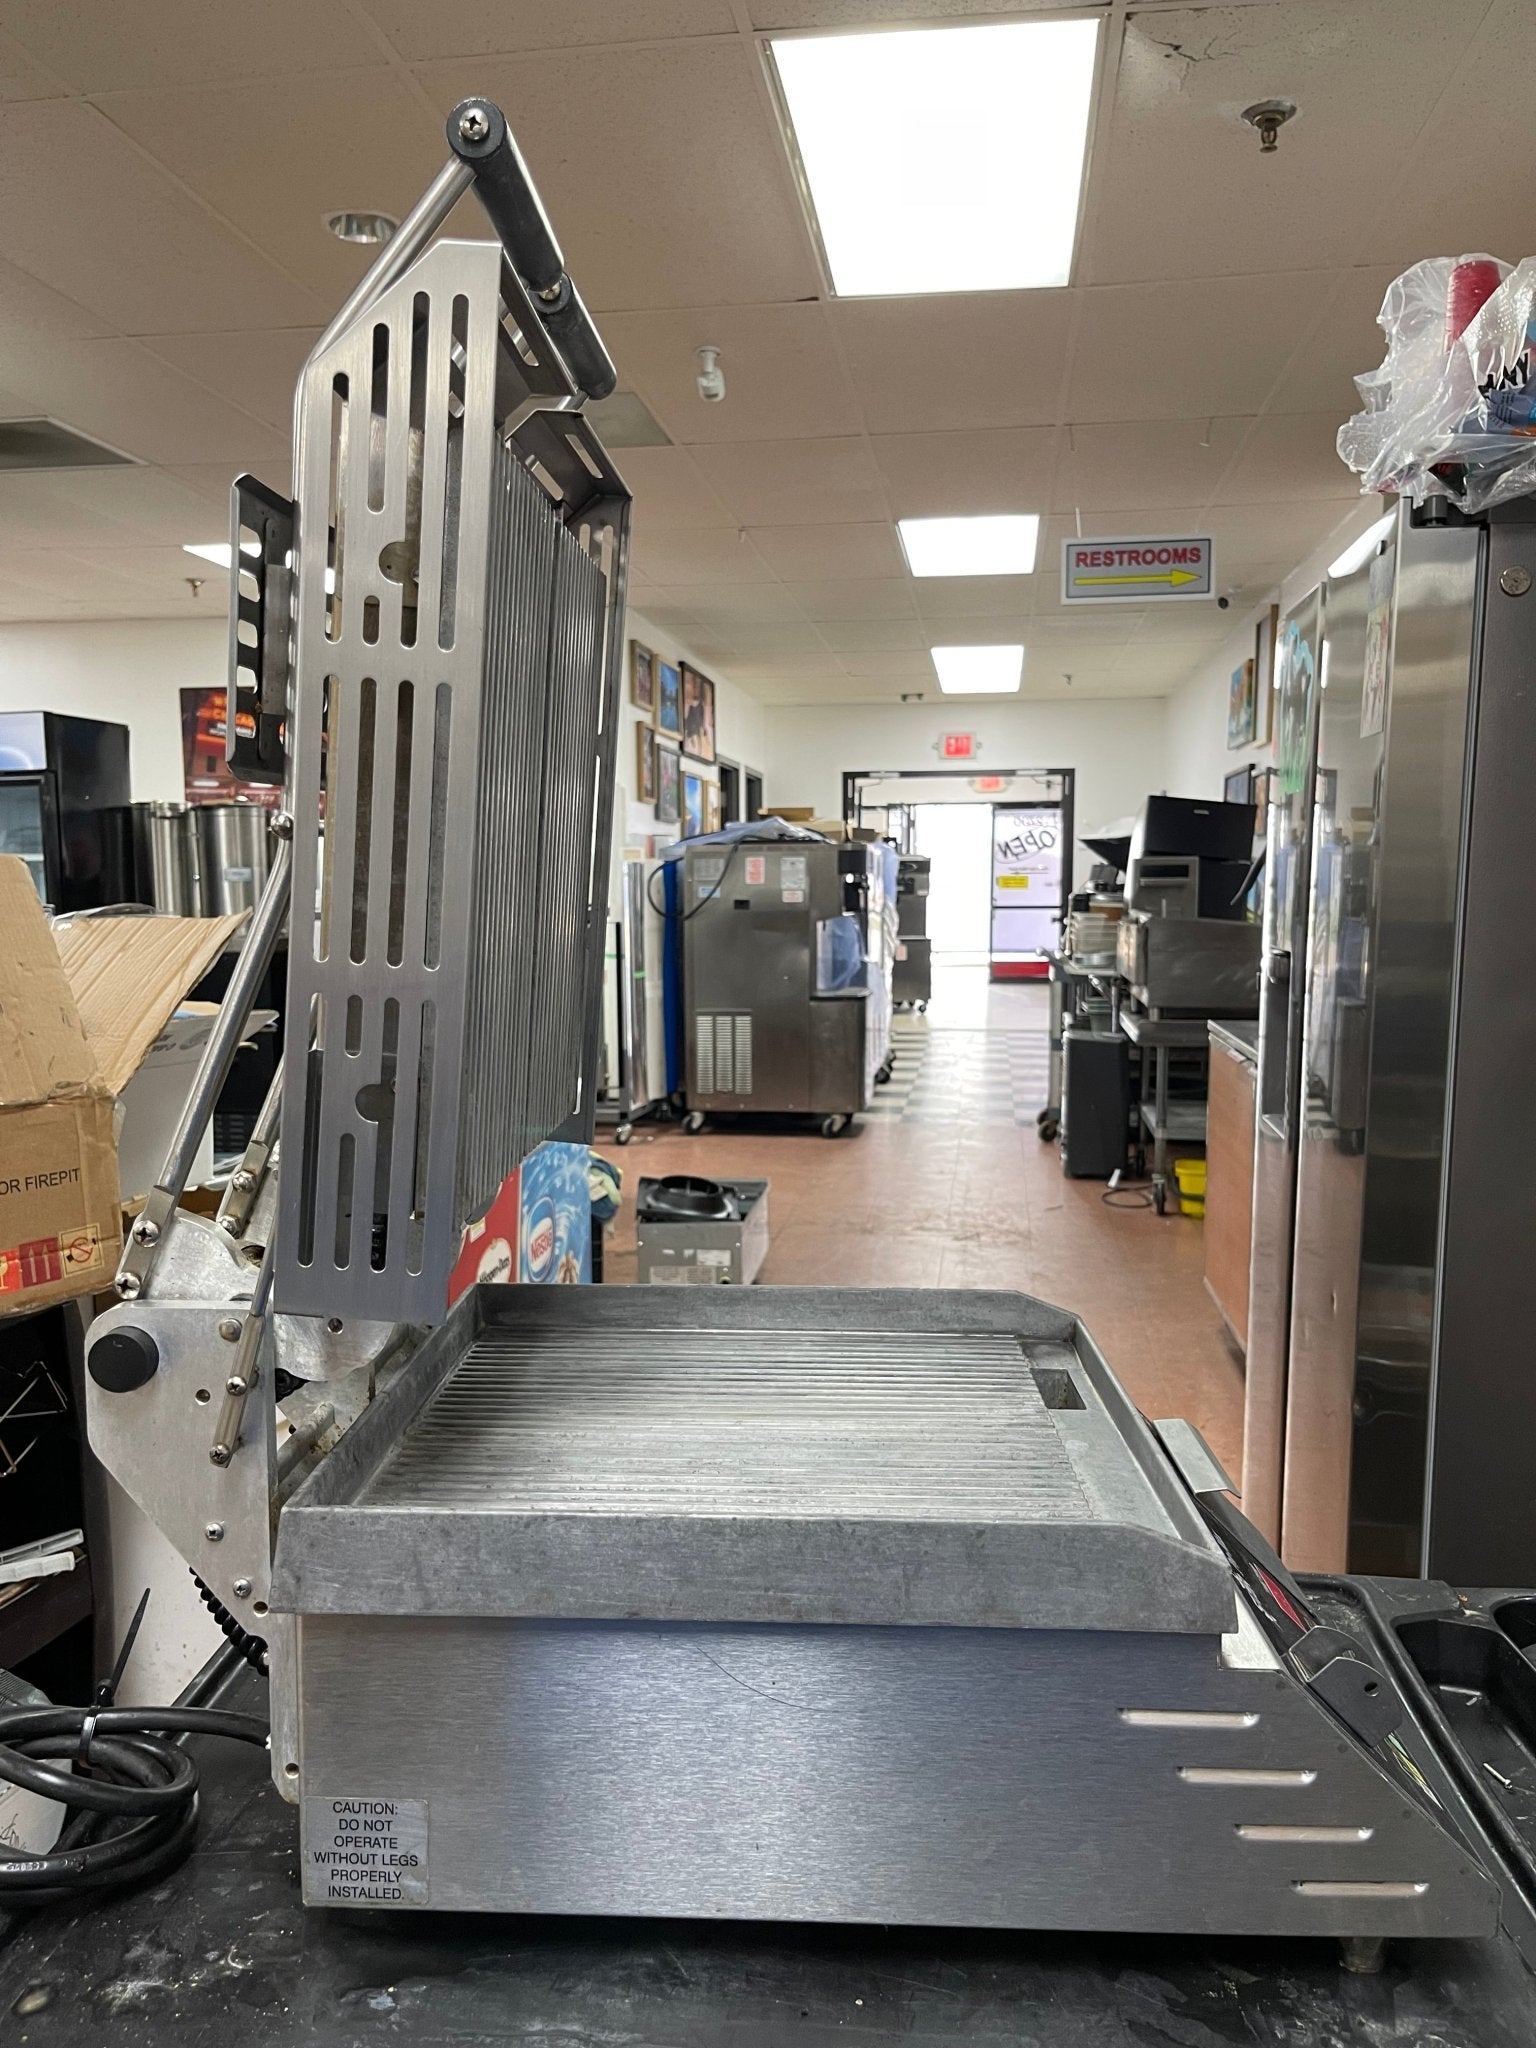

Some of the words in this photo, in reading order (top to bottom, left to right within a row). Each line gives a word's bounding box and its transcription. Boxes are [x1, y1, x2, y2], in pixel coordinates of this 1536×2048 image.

[1075, 547, 1202, 568] RESTROOMS
[25, 1167, 80, 1191] FIREPIT
[332, 1801, 398, 1815] CAUTION:
[339, 1819, 359, 1831] DO
[363, 1820, 393, 1832] NOT
[334, 1836, 398, 1849] OPERATE
[314, 1852, 378, 1865] WITHOUT
[382, 1854, 418, 1867] LEGS
[331, 1869, 402, 1883] PROPERLY
[328, 1886, 405, 1900] INSTALLED.
